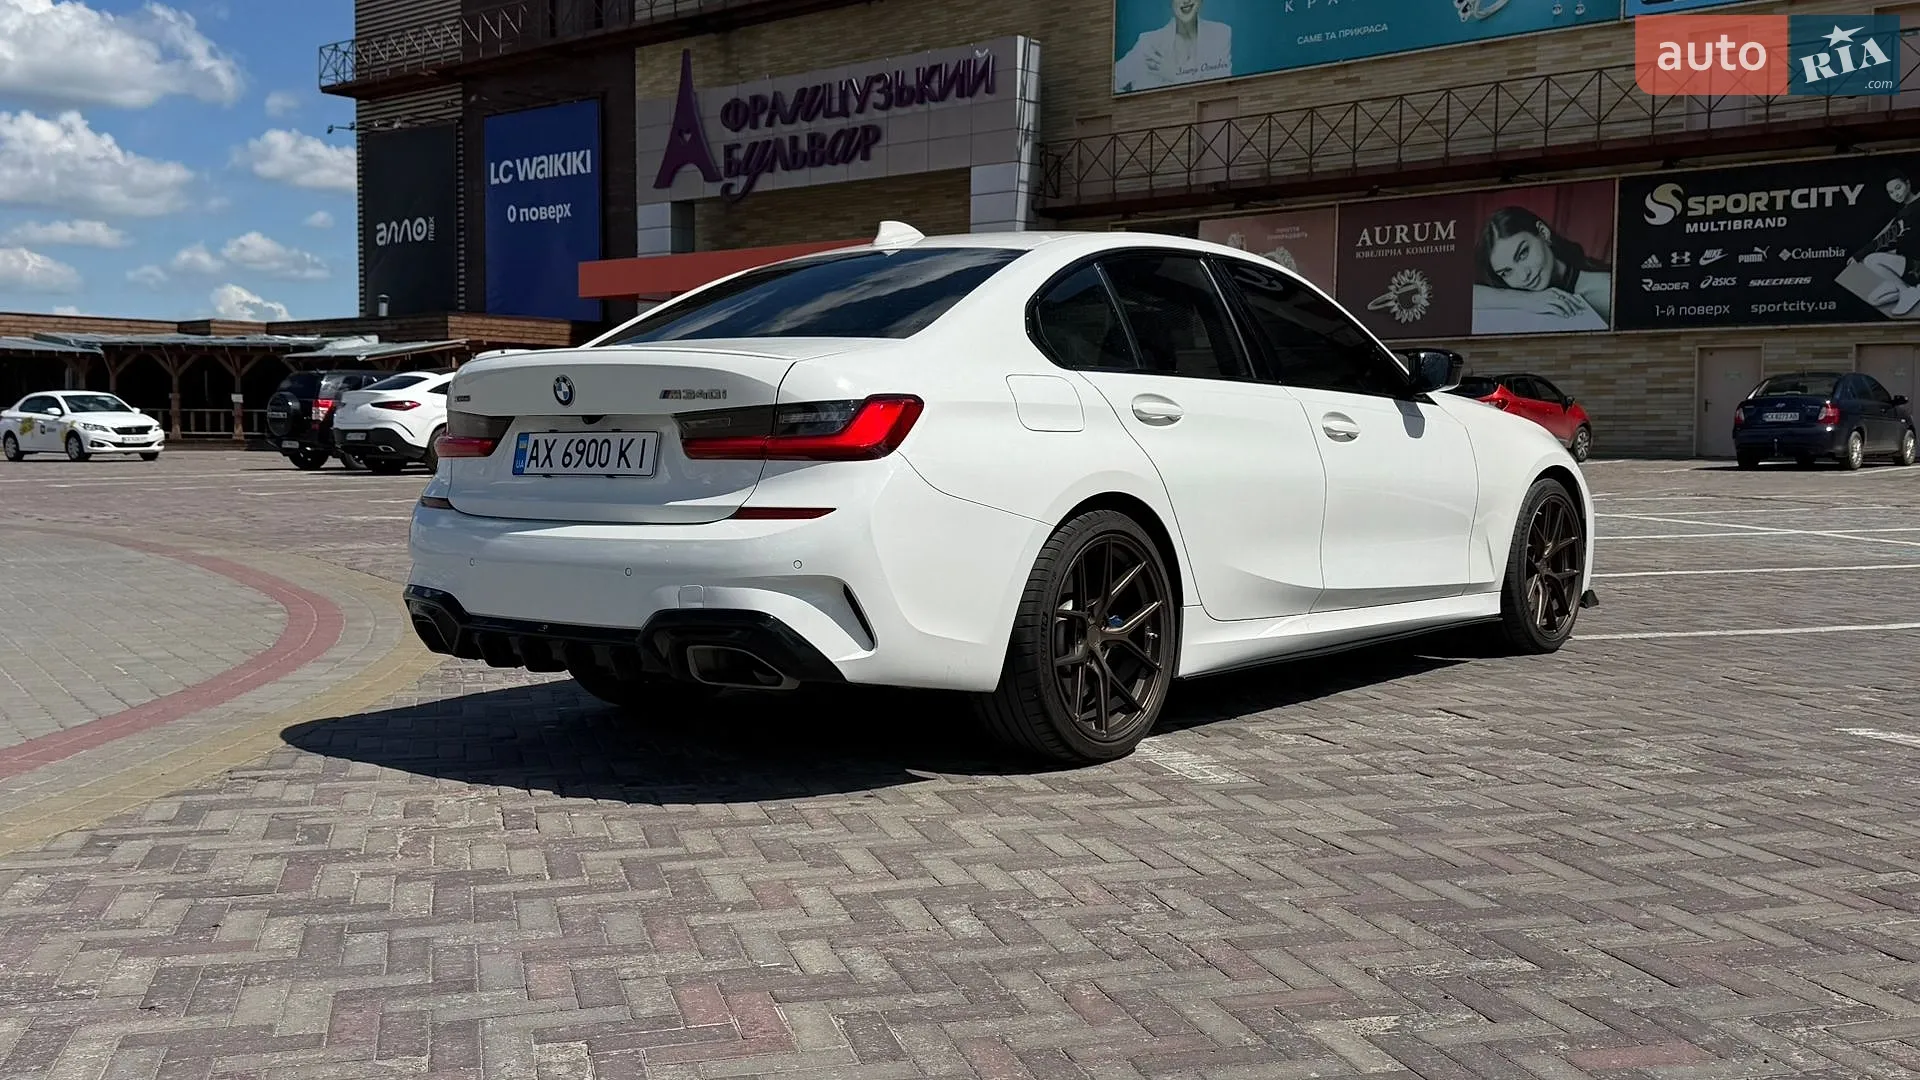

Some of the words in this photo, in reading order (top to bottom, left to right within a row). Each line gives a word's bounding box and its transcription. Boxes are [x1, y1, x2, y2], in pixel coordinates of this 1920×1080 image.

[1297, 33, 1322, 45] САМЕ
[1325, 31, 1337, 40] ТА
[1339, 24, 1388, 38] ПРИКРАСА
[490, 160, 514, 185] LC
[1687, 184, 1865, 216] SPORTCITY
[519, 203, 572, 224] поверх
[1355, 220, 1457, 247] AURUM
[1685, 216, 1788, 234] MULTIBRAND
[1406, 244, 1455, 255] КОМПАНІЯ
[1792, 246, 1846, 259] Columbia
[1748, 276, 1813, 287] SKECHERS
[1655, 304, 1675, 316] 1-й
[1679, 304, 1730, 318] поверх
[1750, 300, 1837, 315] sportcity.ua
[527, 438, 557, 468] AX
[561, 438, 611, 468] 6900
